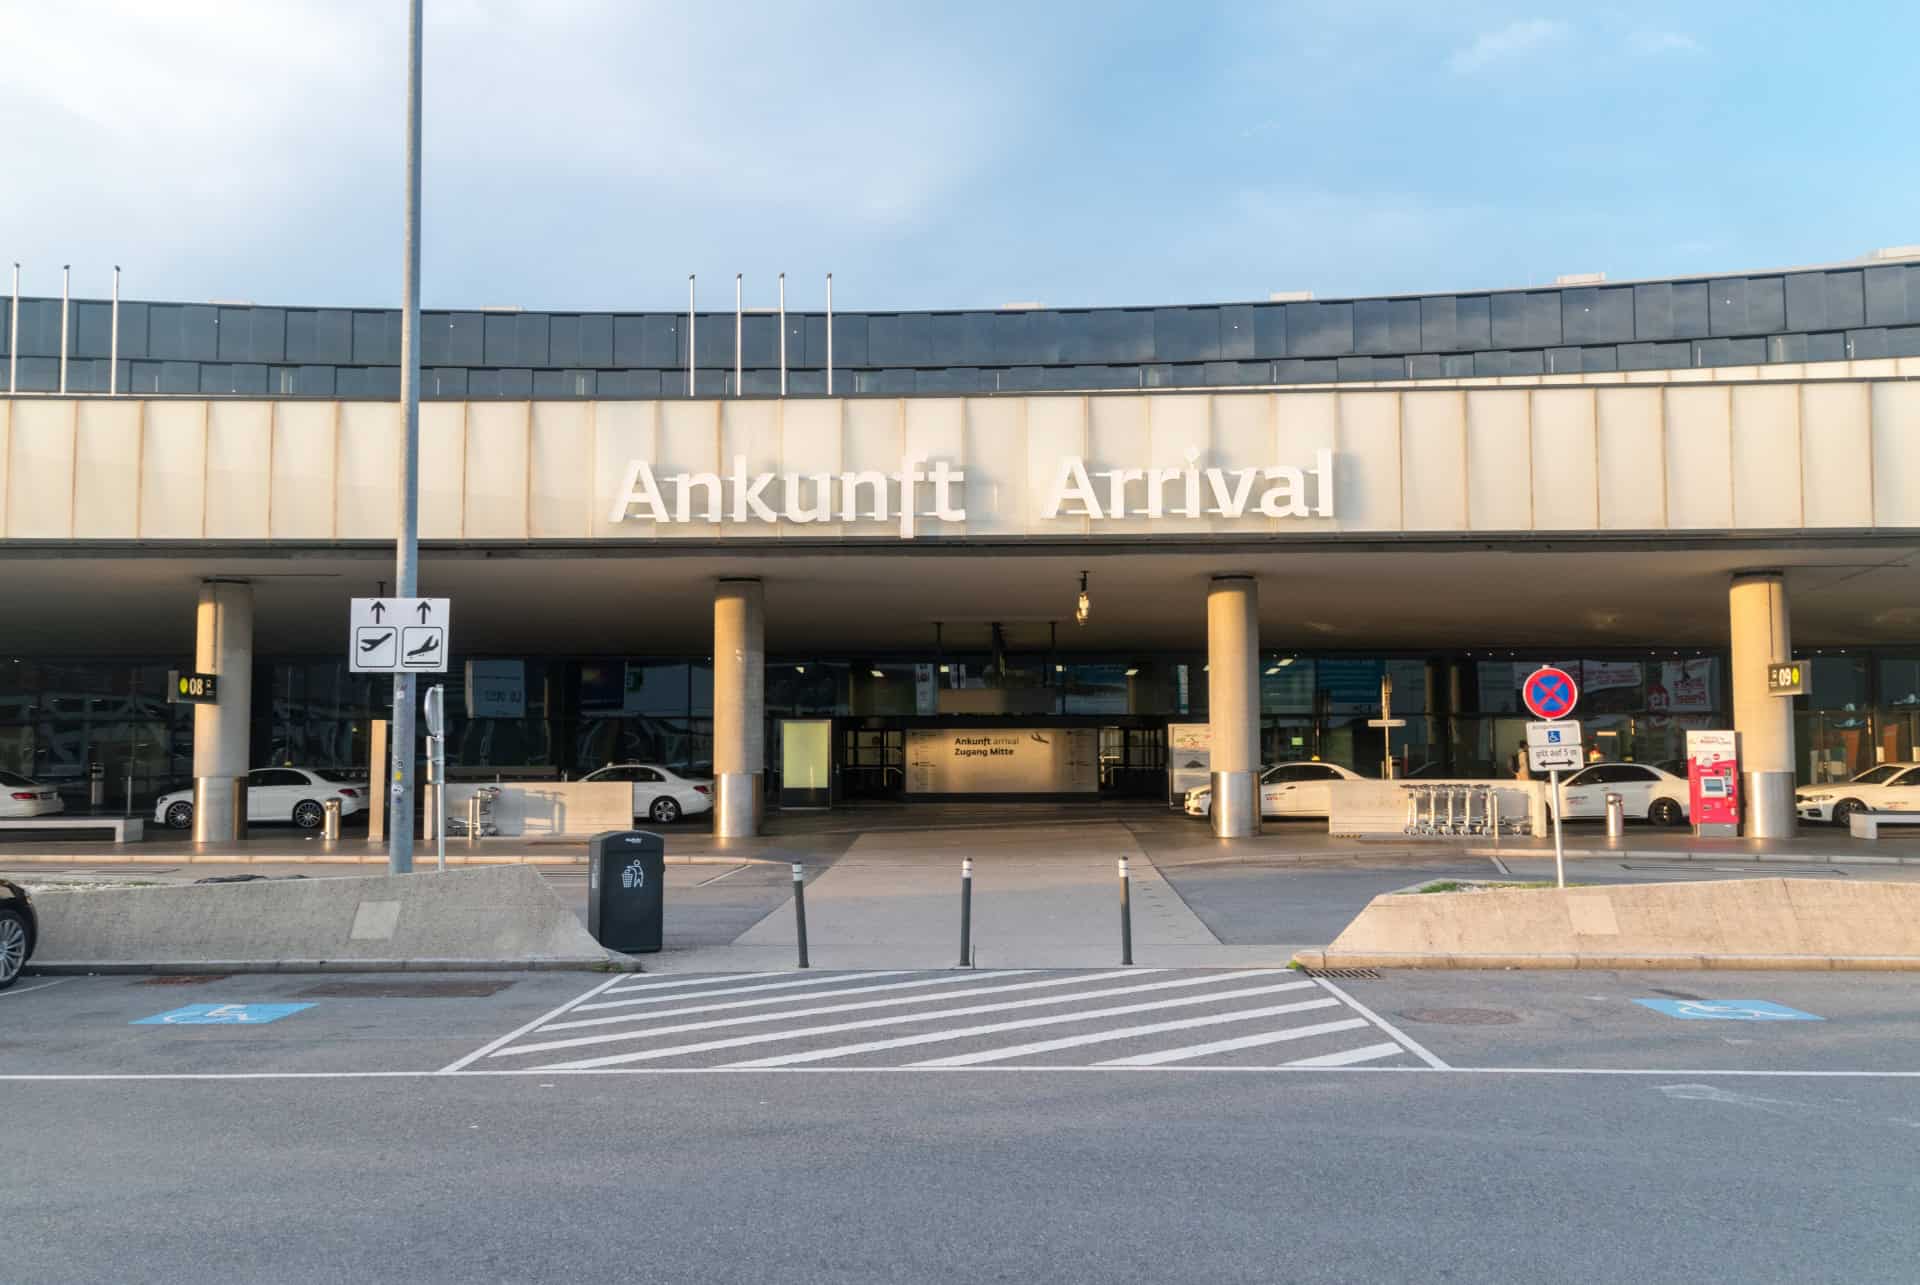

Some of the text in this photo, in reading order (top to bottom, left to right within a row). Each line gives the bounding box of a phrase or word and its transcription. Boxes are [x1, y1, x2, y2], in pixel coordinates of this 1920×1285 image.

[608, 447, 1334, 539] Ankunft Arrival
[1779, 667, 1791, 686] 09
[189, 678, 204, 695] 08
[955, 737, 991, 746] Ankunft
[955, 748, 1014, 757] Zugang Mitte
